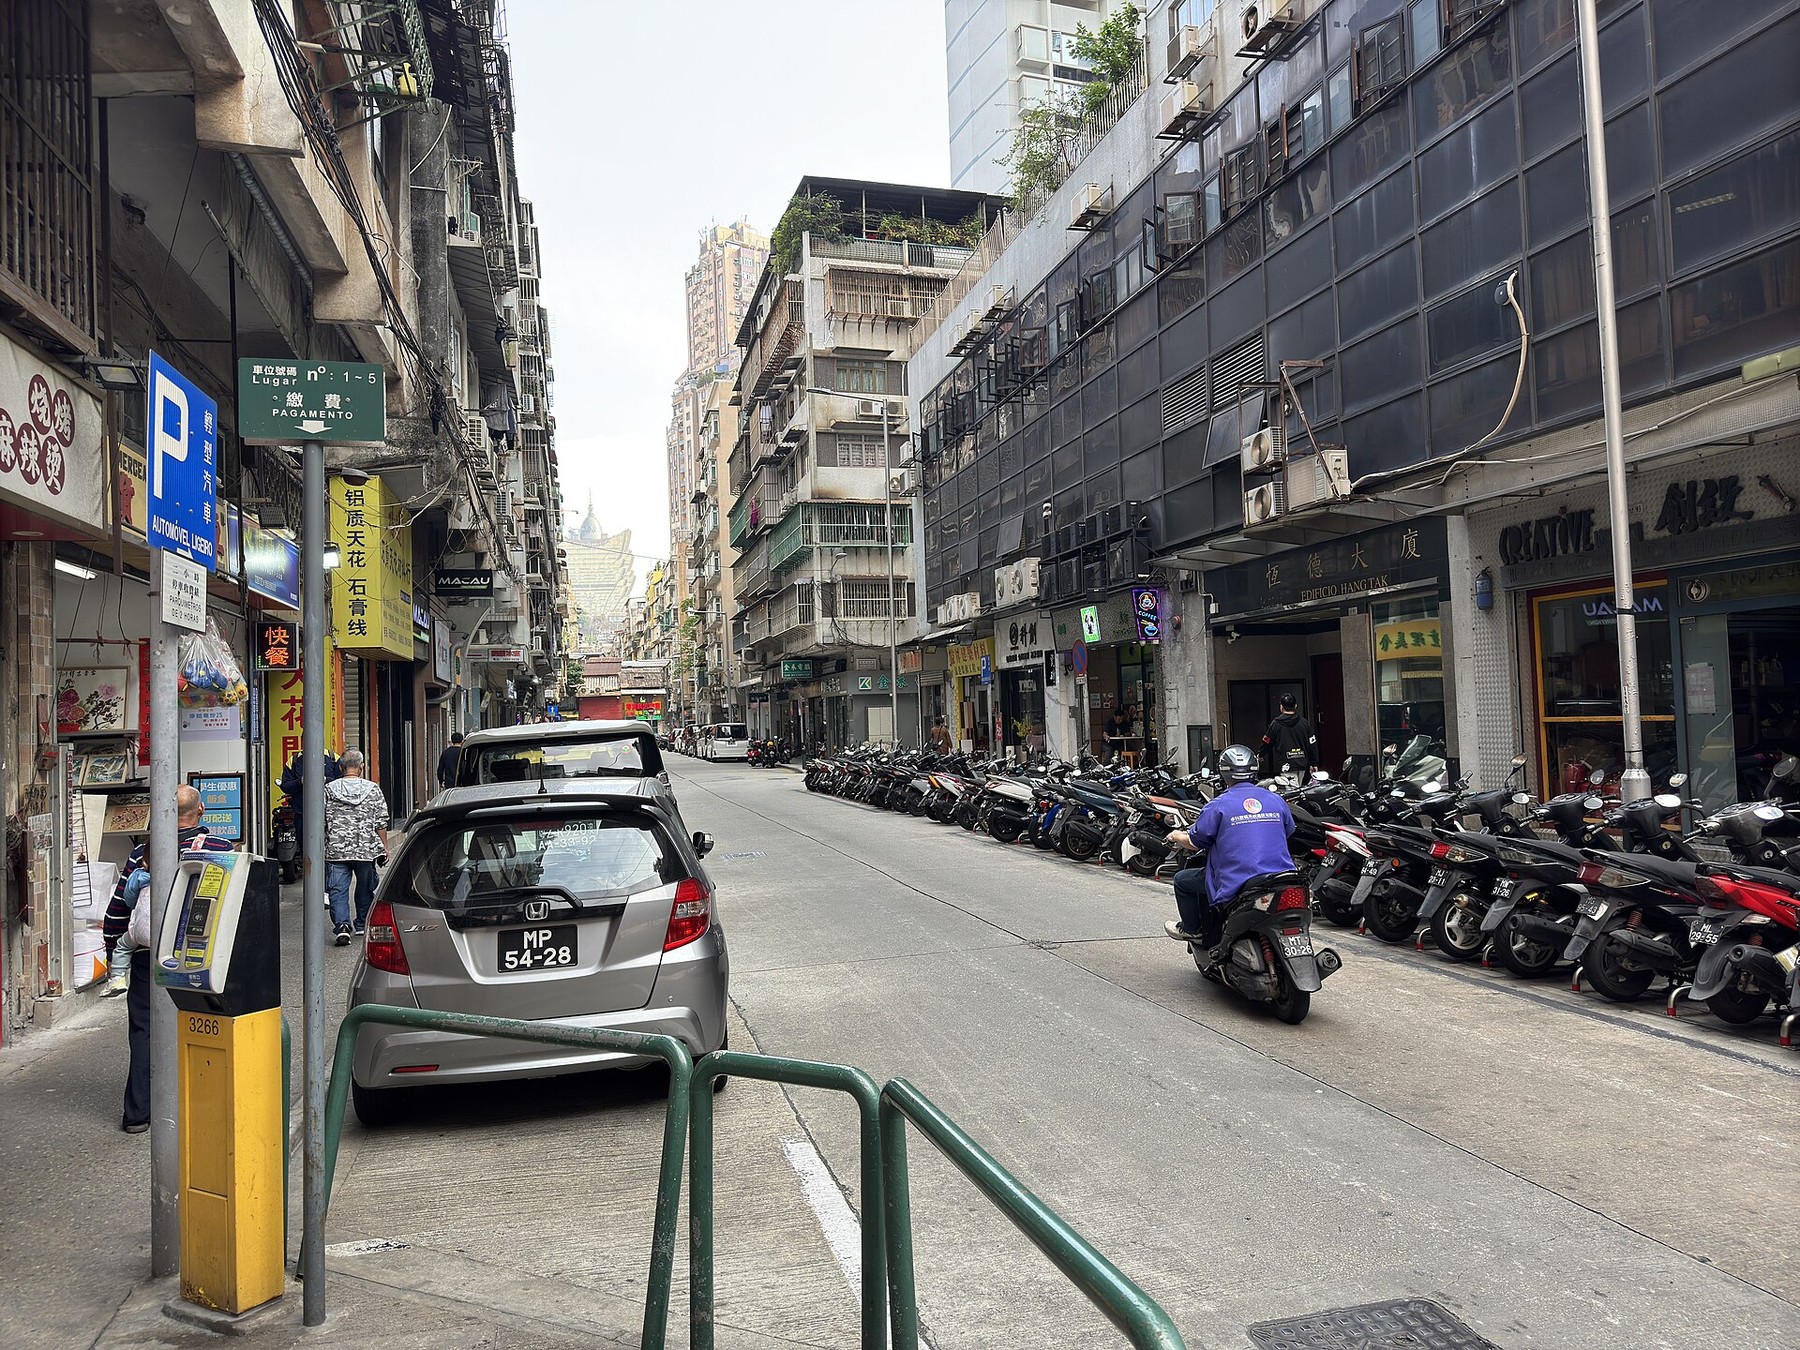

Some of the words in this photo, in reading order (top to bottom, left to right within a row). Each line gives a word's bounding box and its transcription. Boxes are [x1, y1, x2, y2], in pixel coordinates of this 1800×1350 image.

[252, 365, 297, 377] 車位號碼
[252, 375, 297, 387] Lugar
[286, 392, 341, 409] 繳費
[272, 408, 354, 420] PAGAMENTO
[153, 371, 189, 499] P
[202, 409, 213, 525] 輕型汽車
[152, 513, 191, 548] AUTOMÓVEL
[191, 533, 213, 558] LIGEIRO
[345, 489, 366, 568] 铝质天花
[172, 564, 200, 583] 二小時
[438, 577, 490, 585] MACAU
[179, 609, 183, 619] 2
[184, 611, 199, 624] HORAS
[347, 578, 368, 637] 石膏线
[1138, 610, 1157, 621] COFFEE
[265, 626, 290, 666] 快餐
[1700, 923, 1712, 933] ML
[523, 929, 552, 950] MP
[1288, 936, 1301, 946] MT
[1690, 931, 1719, 944] 29-55
[504, 946, 571, 969] 54-28
[189, 1017, 220, 1036] 3266
